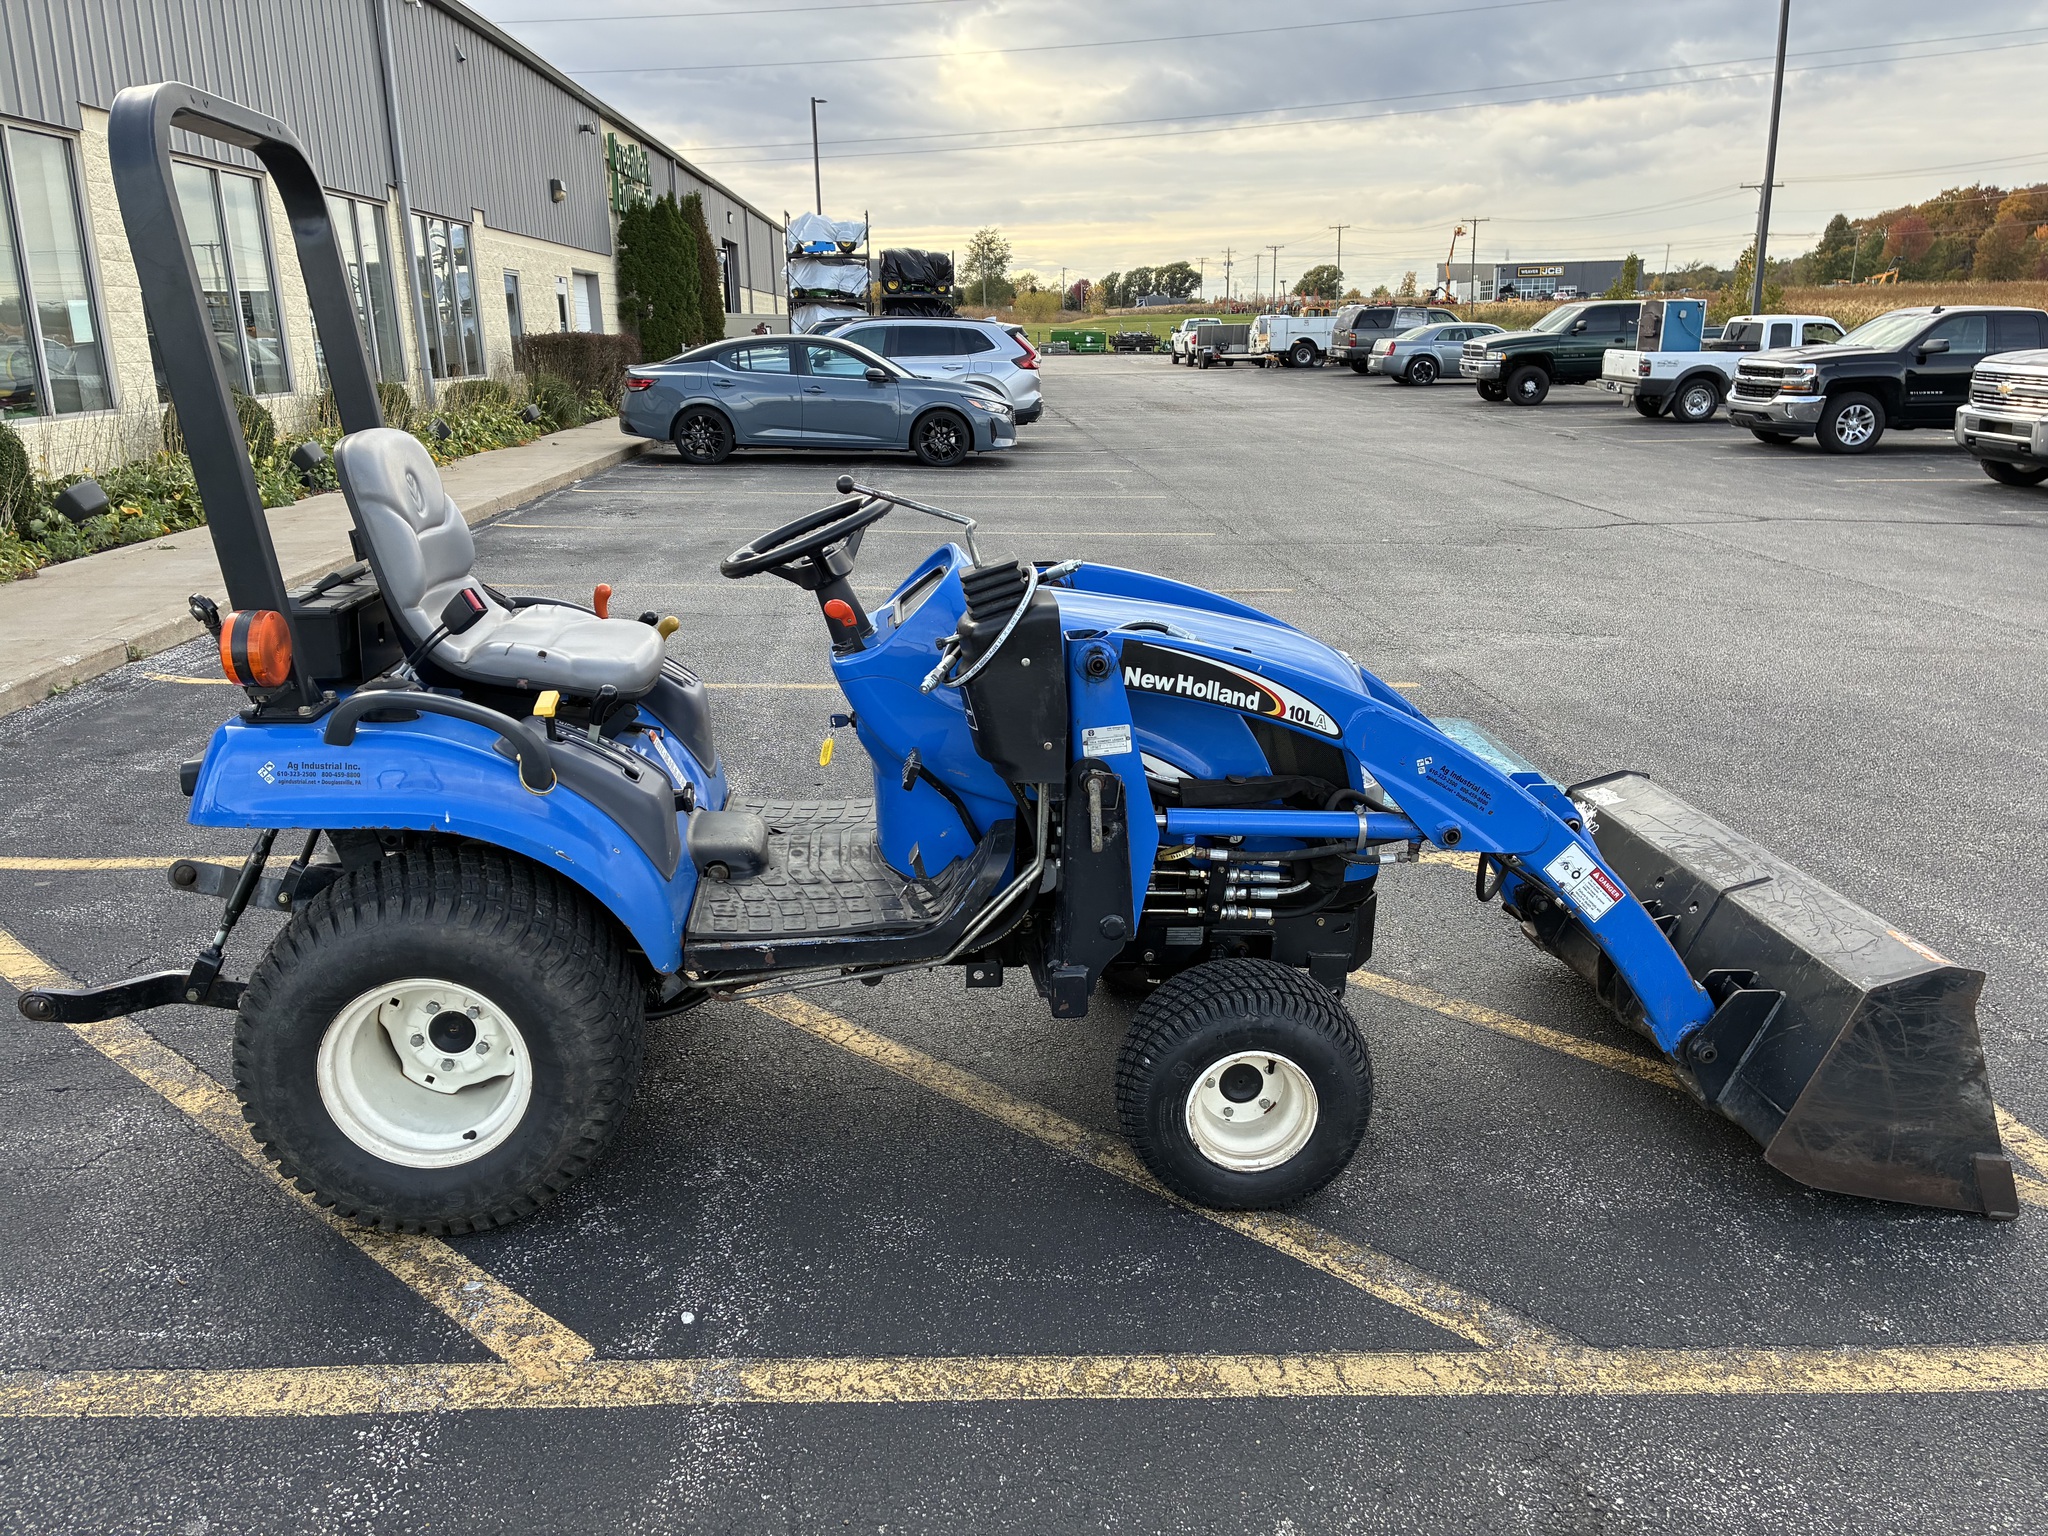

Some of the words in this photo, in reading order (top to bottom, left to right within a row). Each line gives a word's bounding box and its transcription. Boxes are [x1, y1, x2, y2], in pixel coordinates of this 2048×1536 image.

[1123, 666, 1176, 692] New
[1176, 674, 1260, 711] Holland
[1288, 705, 1327, 730] 10LA
[287, 761, 299, 770] Ag
[301, 761, 342, 770] Industrial
[344, 762, 361, 770] Inc.
[1439, 764, 1449, 776] Ag
[1449, 769, 1482, 793] Industrial
[1480, 786, 1492, 801] Inc.
[1598, 876, 1620, 899] DANGER
